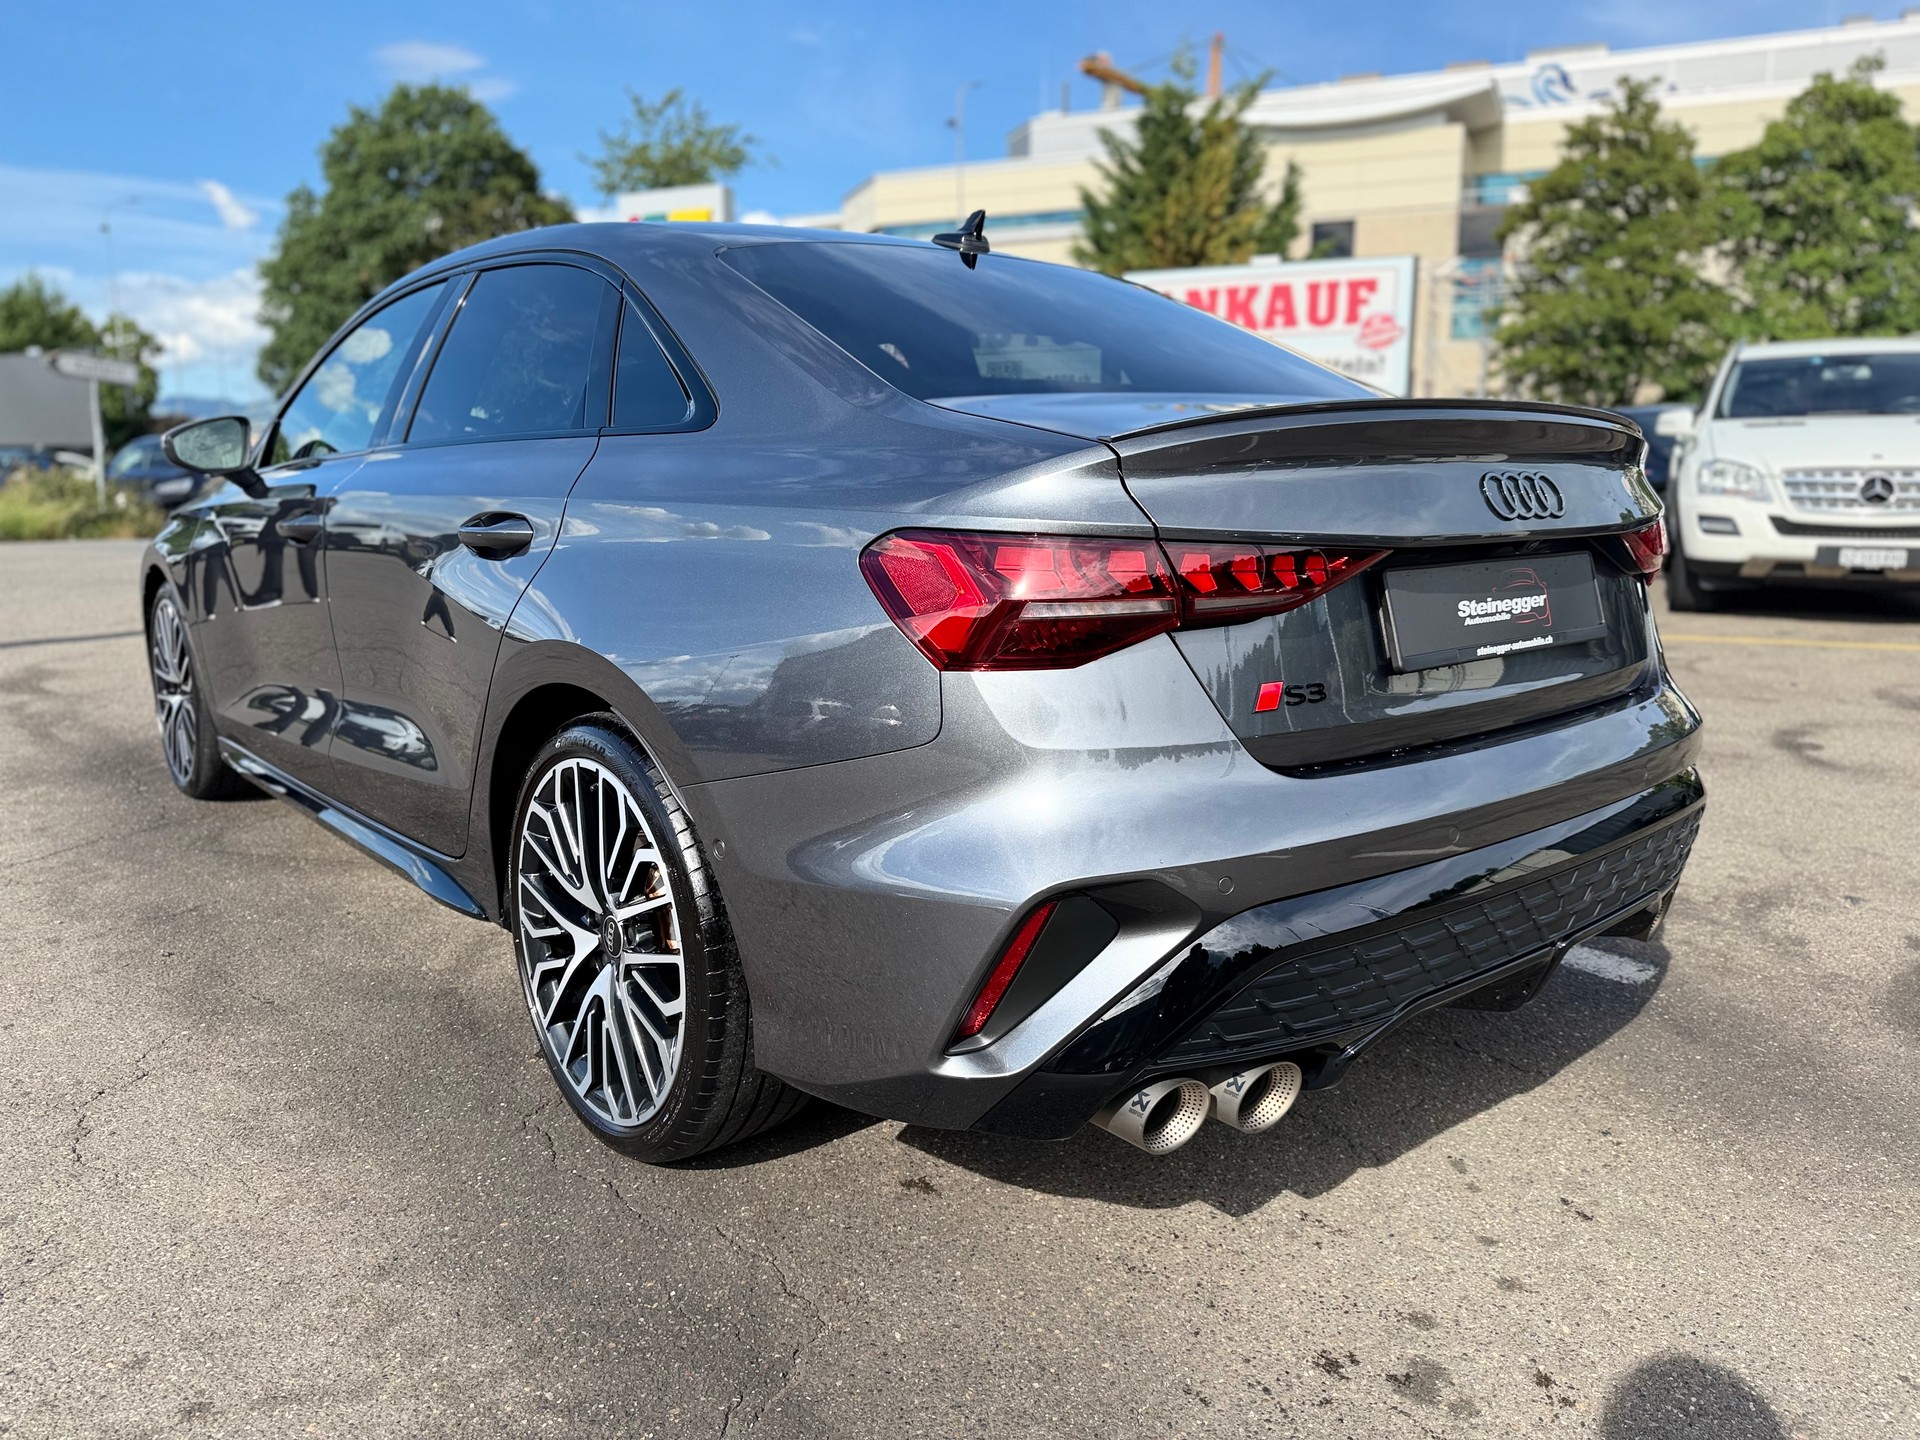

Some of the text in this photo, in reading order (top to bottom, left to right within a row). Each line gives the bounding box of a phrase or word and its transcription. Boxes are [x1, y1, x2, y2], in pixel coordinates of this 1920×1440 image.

[1163, 278, 1378, 332] NKAUF
[1457, 594, 1547, 618] Steinegger
[1463, 612, 1512, 626] Automobile
[1476, 635, 1554, 656] steinegger-automobile.ch
[1284, 682, 1327, 706] S3
